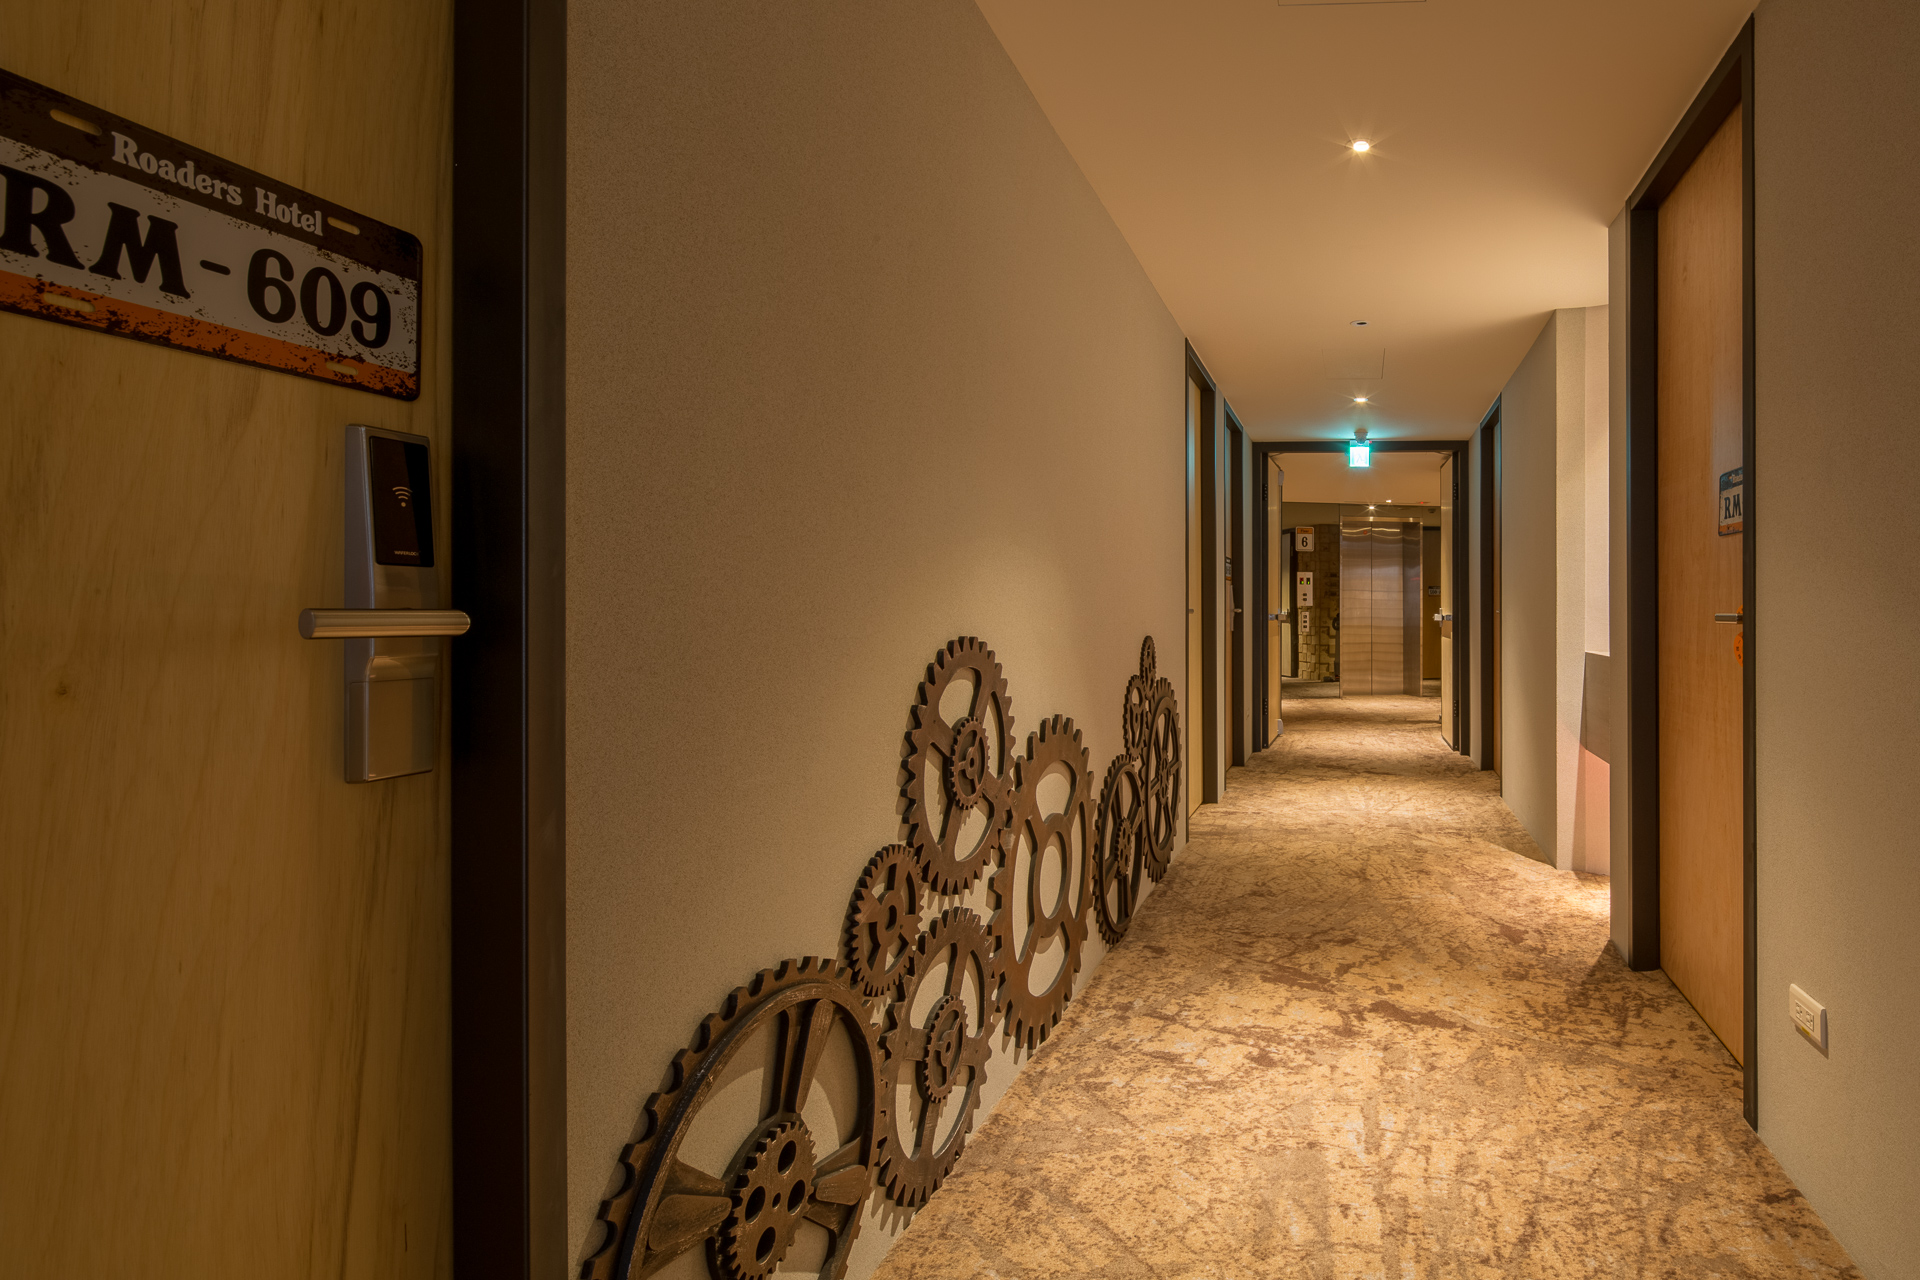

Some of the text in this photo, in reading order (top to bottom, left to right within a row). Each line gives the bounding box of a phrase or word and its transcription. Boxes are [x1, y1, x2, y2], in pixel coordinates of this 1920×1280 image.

[111, 131, 324, 237] Roaders Hotel
[0, 164, 392, 349] RM-609
[1302, 536, 1308, 548] 6
